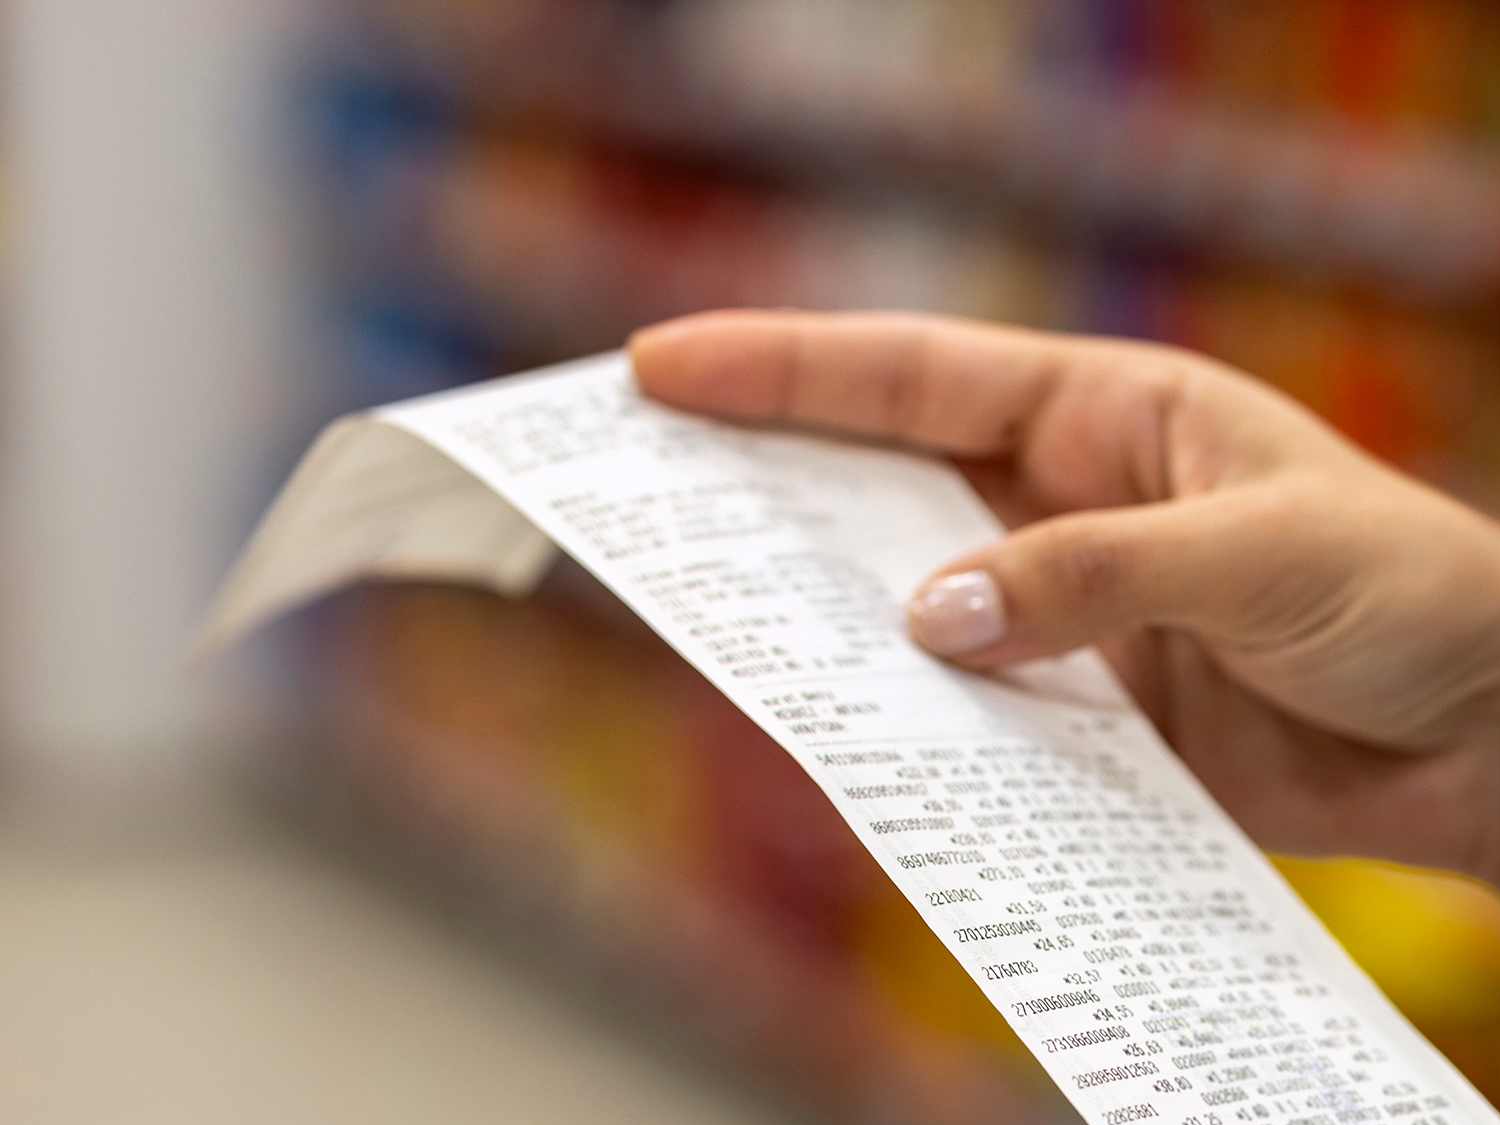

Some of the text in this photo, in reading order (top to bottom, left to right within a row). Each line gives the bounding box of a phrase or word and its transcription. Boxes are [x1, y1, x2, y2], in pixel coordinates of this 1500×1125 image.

[925, 888, 983, 907] 22180421
[953, 919, 1042, 943] 2701253030445
[981, 960, 1038, 980] 21764783
[1011, 989, 1102, 1017] 2719006009846
[1041, 1025, 1131, 1053] 2731866009408
[1072, 1061, 1160, 1090] 2928859012563
